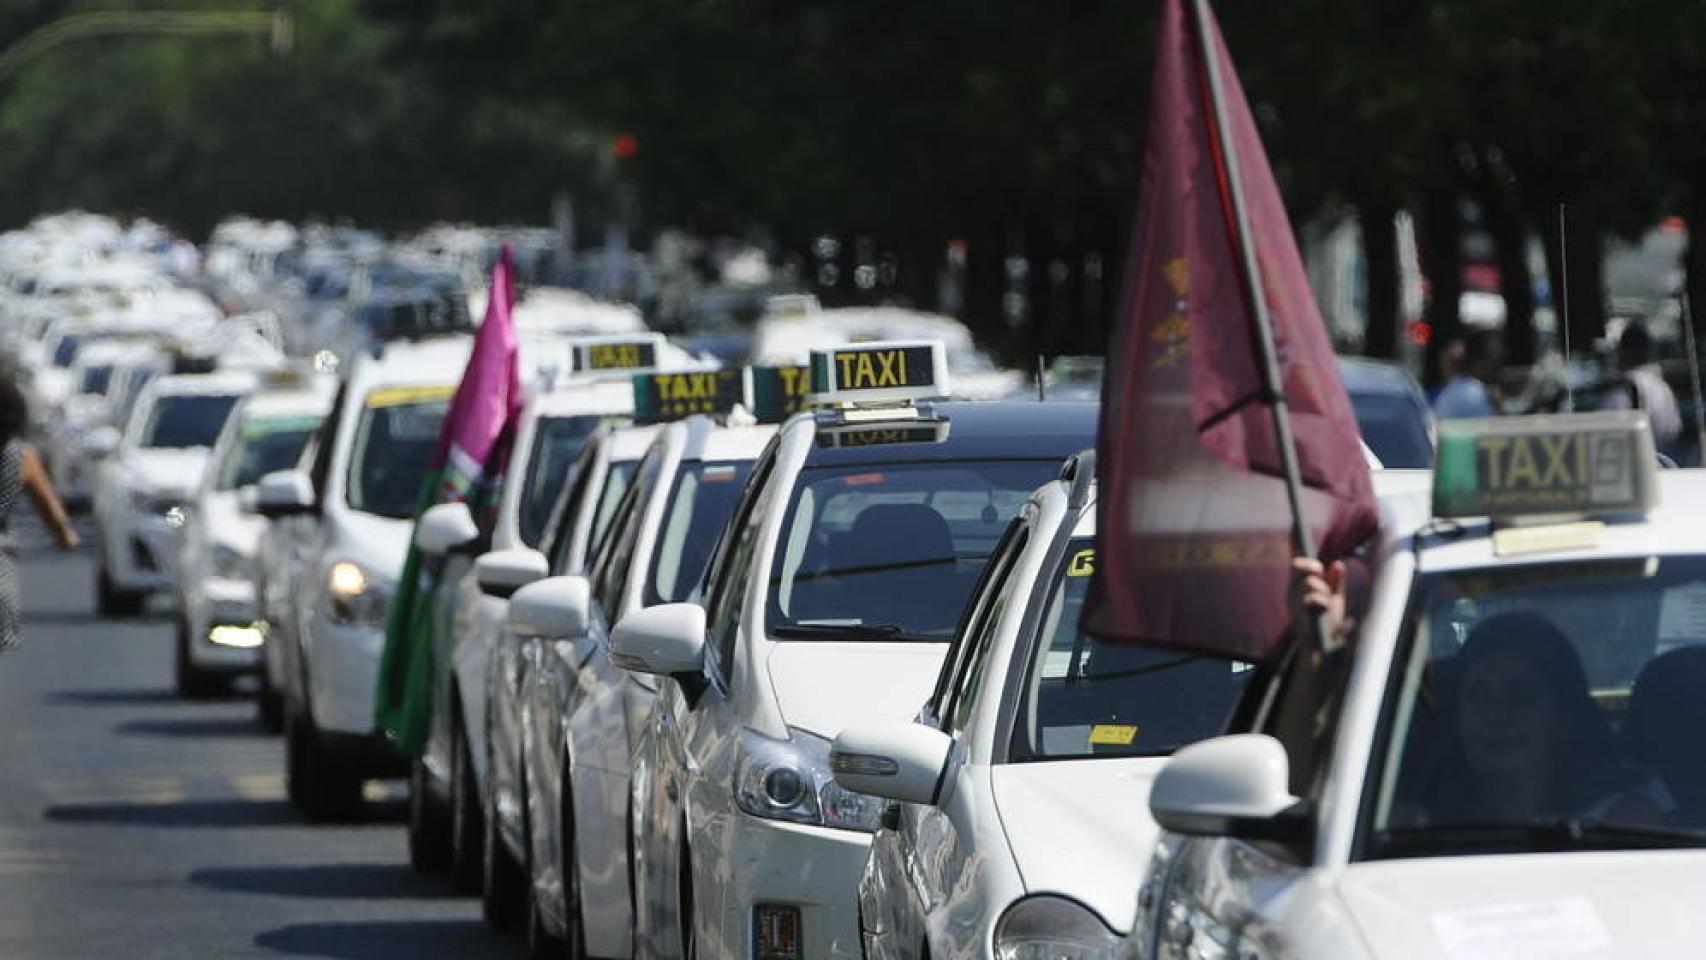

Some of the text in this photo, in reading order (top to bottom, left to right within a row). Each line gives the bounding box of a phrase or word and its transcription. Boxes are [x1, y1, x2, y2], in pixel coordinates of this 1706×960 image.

[656, 374, 717, 400] TAXI
[834, 350, 907, 388] TAXI
[1479, 433, 1588, 488] TAXI
